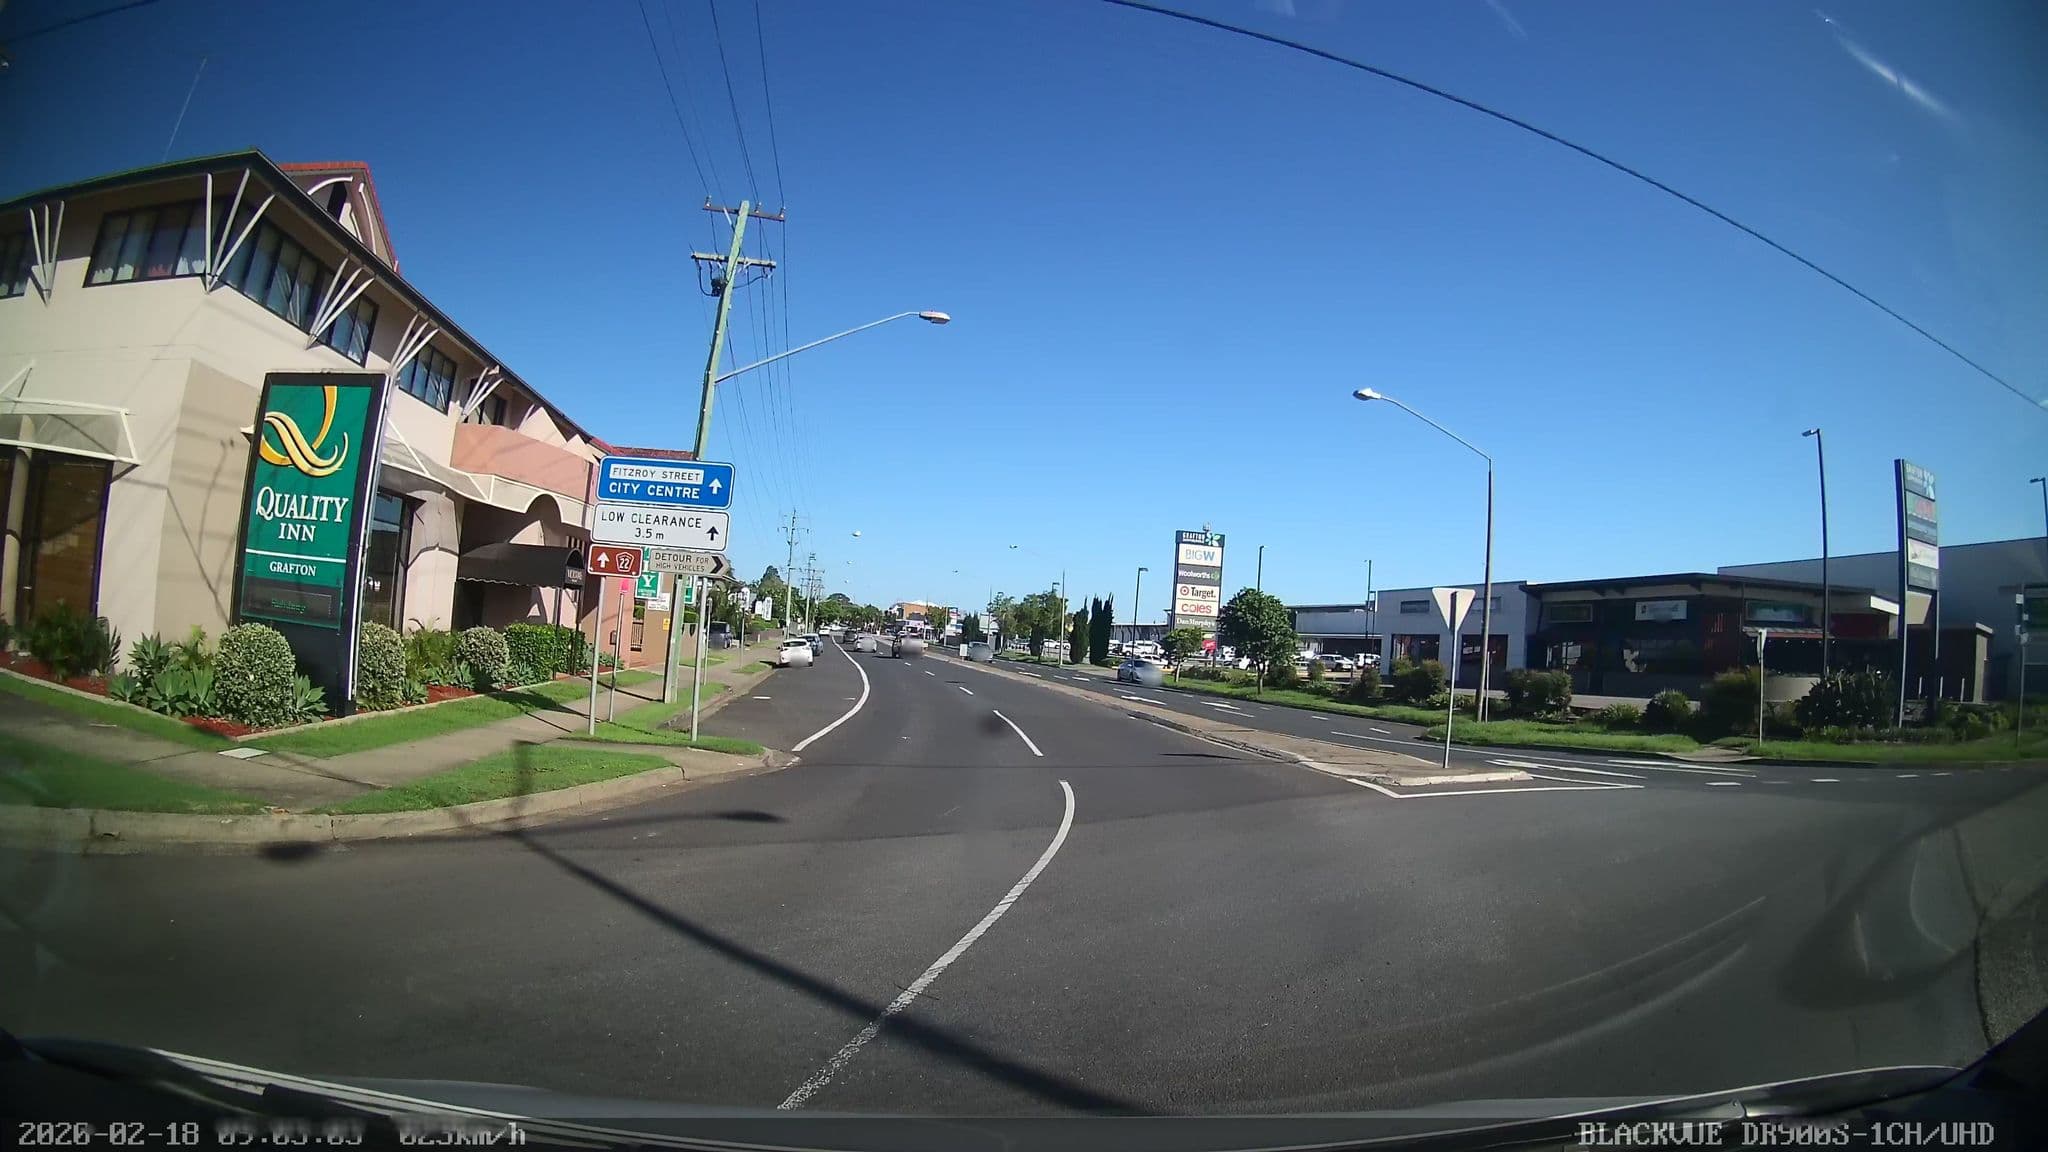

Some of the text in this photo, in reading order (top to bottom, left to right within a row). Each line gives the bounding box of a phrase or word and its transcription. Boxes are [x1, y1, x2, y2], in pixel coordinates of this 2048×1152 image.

[612, 467, 700, 480] FITZROY STREET
[609, 482, 700, 499] CITY CENTRE
[255, 486, 349, 523] QUALITY
[601, 511, 702, 528] LOW CLEARANCE
[278, 523, 316, 542] INN
[635, 527, 652, 539] 3.5
[619, 557, 629, 569] 22
[654, 552, 709, 565] DETOUR FOR
[269, 560, 317, 577] GRAFTON
[674, 564, 705, 573] VEHICLES
[1181, 603, 1212, 614] coles
